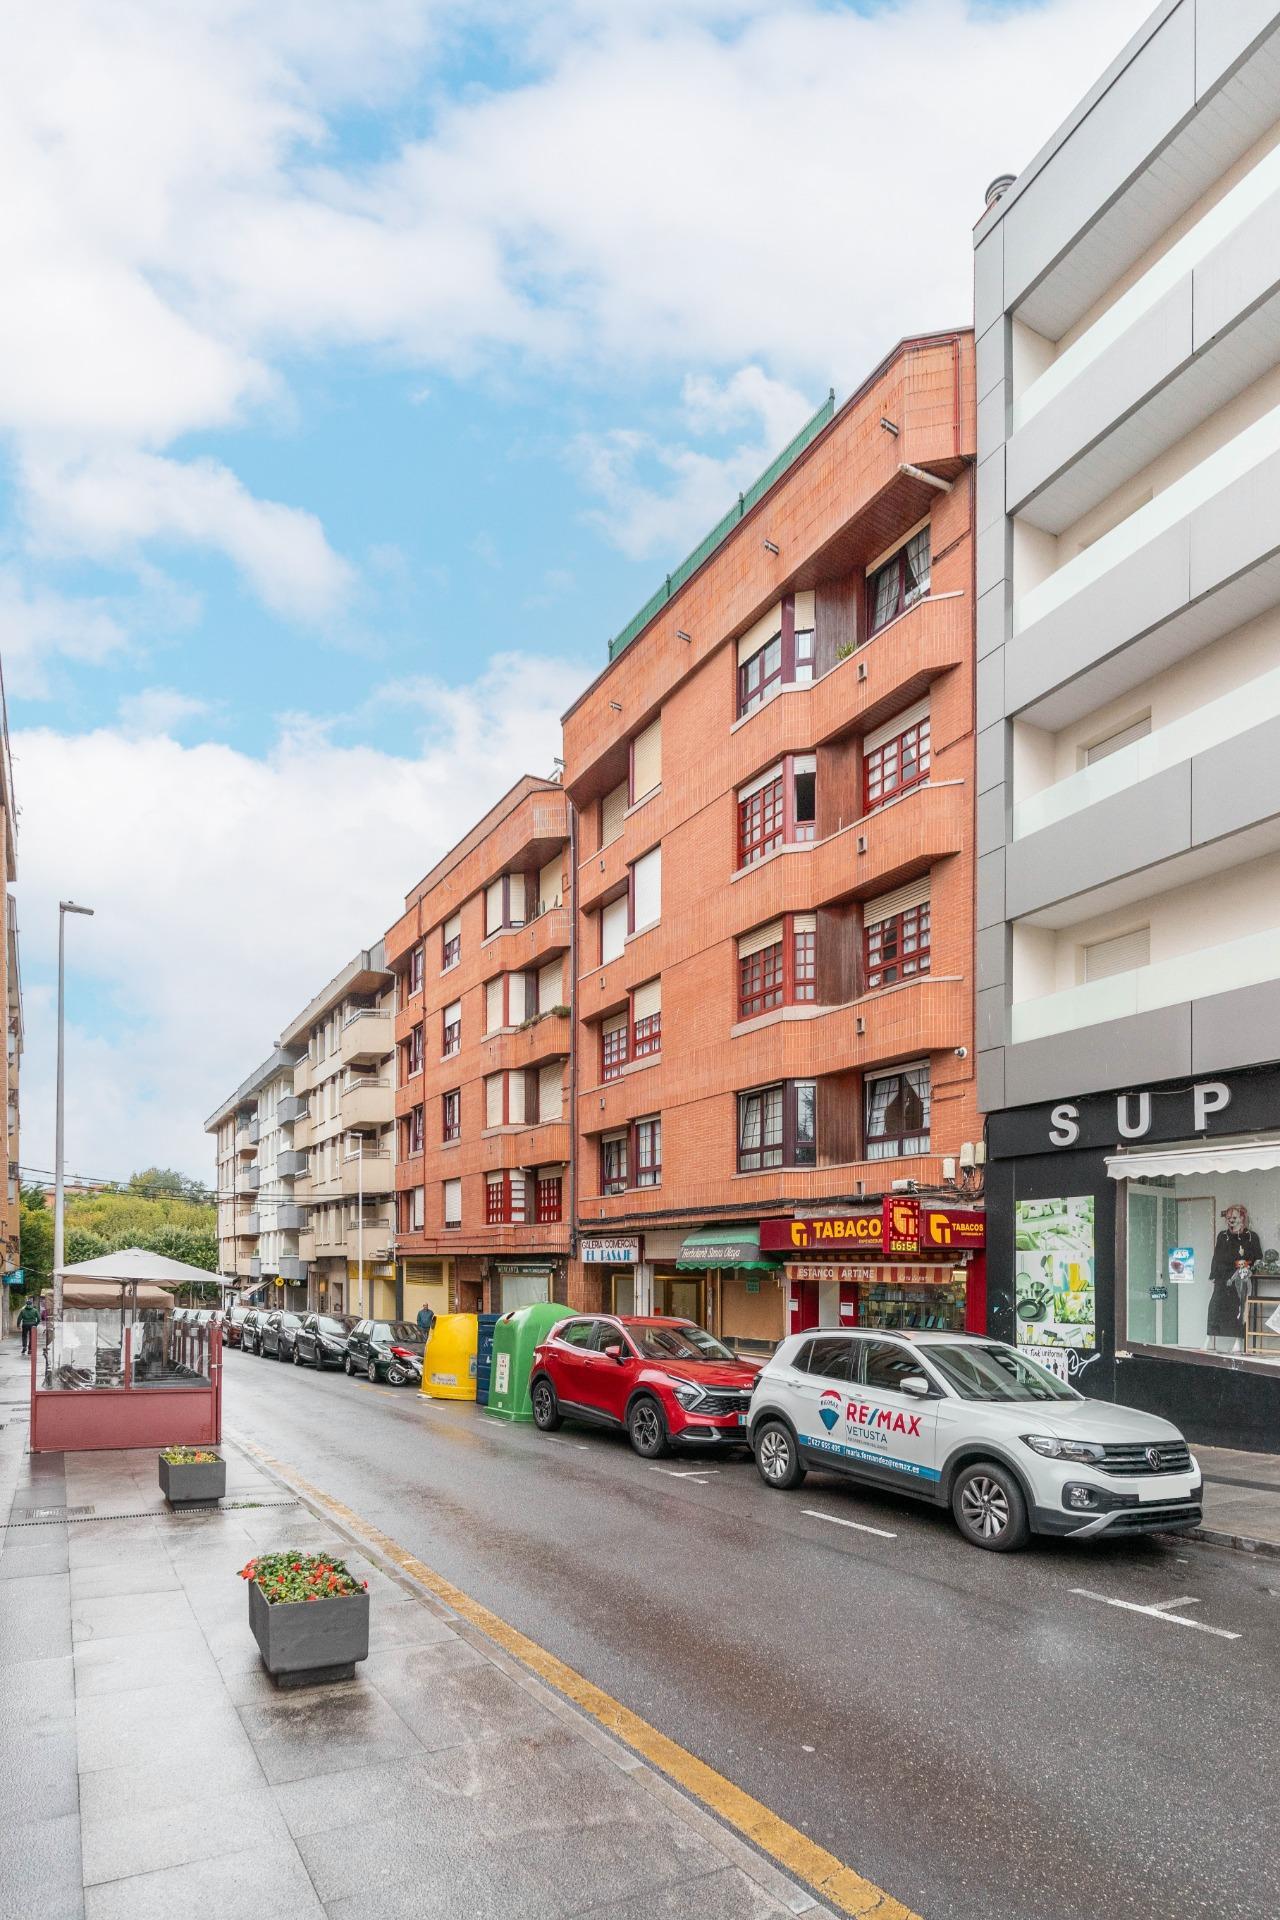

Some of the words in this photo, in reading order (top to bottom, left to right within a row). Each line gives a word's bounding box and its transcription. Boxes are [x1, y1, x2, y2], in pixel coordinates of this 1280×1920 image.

[812, 1219, 883, 1239] TABACO
[952, 1222, 984, 1232] TABACOS
[581, 1239, 603, 1249] GALERIA
[604, 1238, 638, 1249] COMERCIAL
[890, 1240, 917, 1252] 16:54
[586, 1250, 596, 1261] EL
[600, 1249, 633, 1261] PASAJE
[799, 1268, 834, 1278] ESTANCO
[841, 1268, 875, 1279] ARTIME
[846, 1402, 922, 1437] RE/MAX
[847, 1425, 888, 1443] VETUSTA
